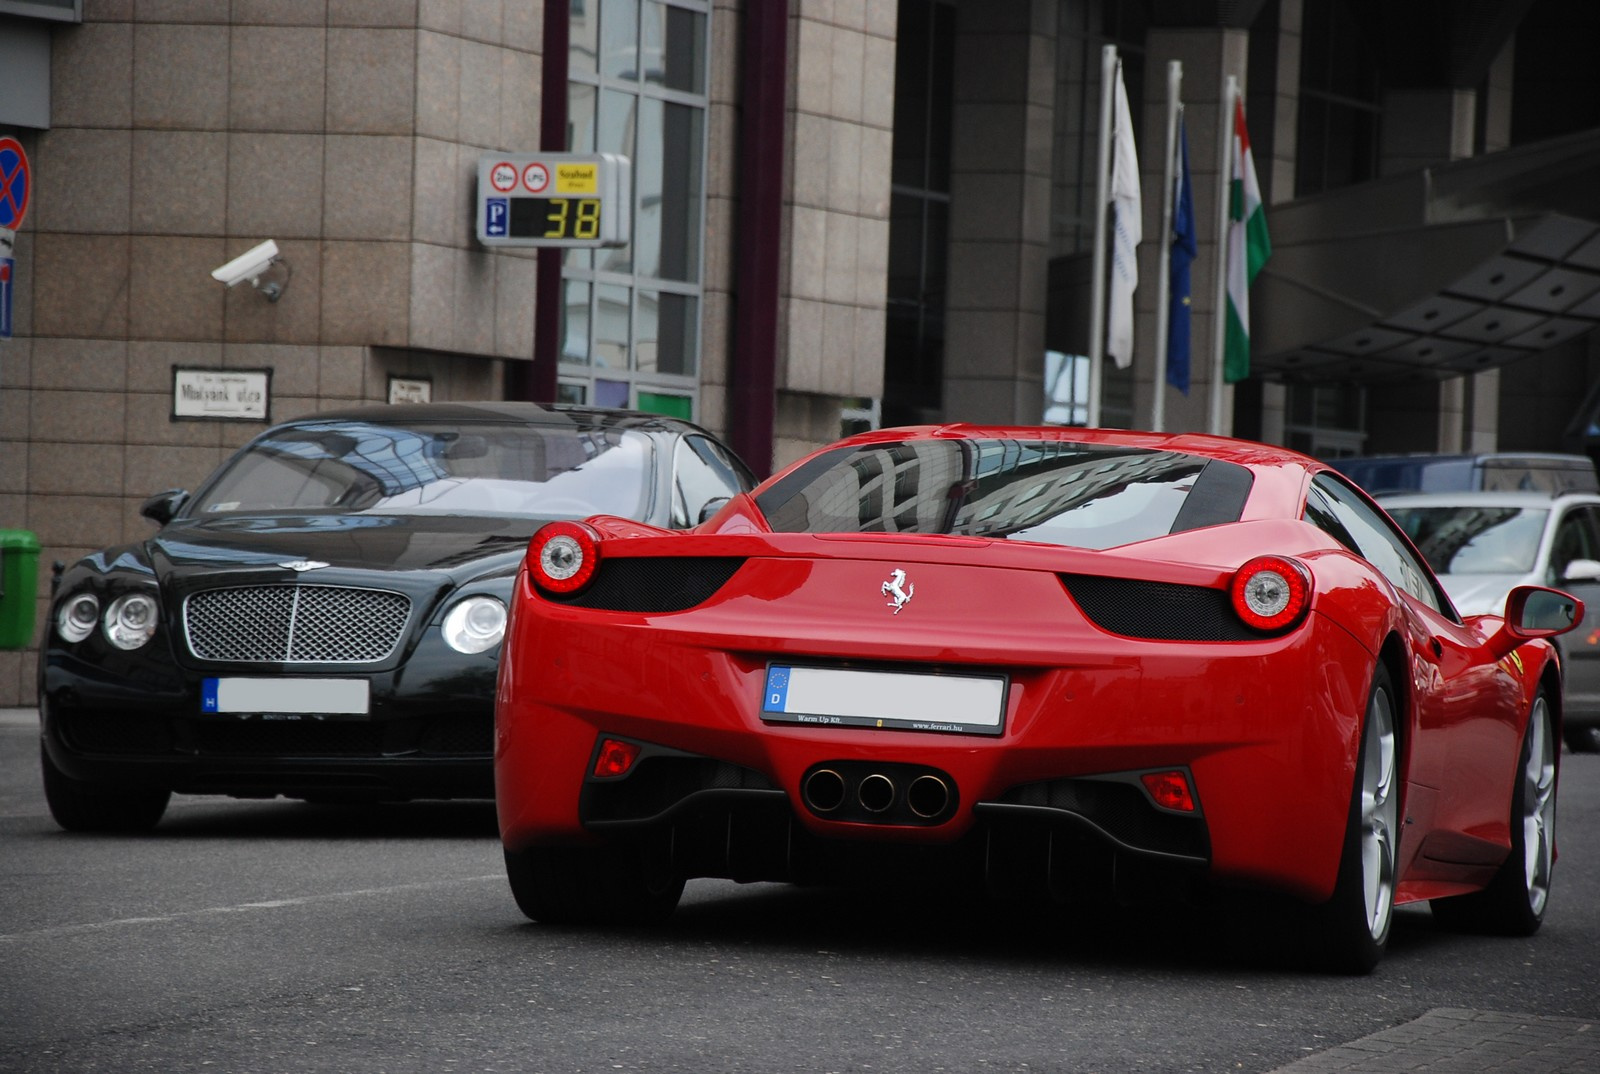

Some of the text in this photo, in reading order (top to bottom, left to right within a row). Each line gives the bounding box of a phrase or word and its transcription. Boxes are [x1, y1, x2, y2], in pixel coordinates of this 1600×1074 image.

[491, 204, 504, 223] P
[544, 199, 601, 239] 38
[206, 698, 215, 707] H
[771, 693, 781, 704] D
[819, 716, 829, 724] Up
[912, 723, 963, 731] www.ferrari.hu
